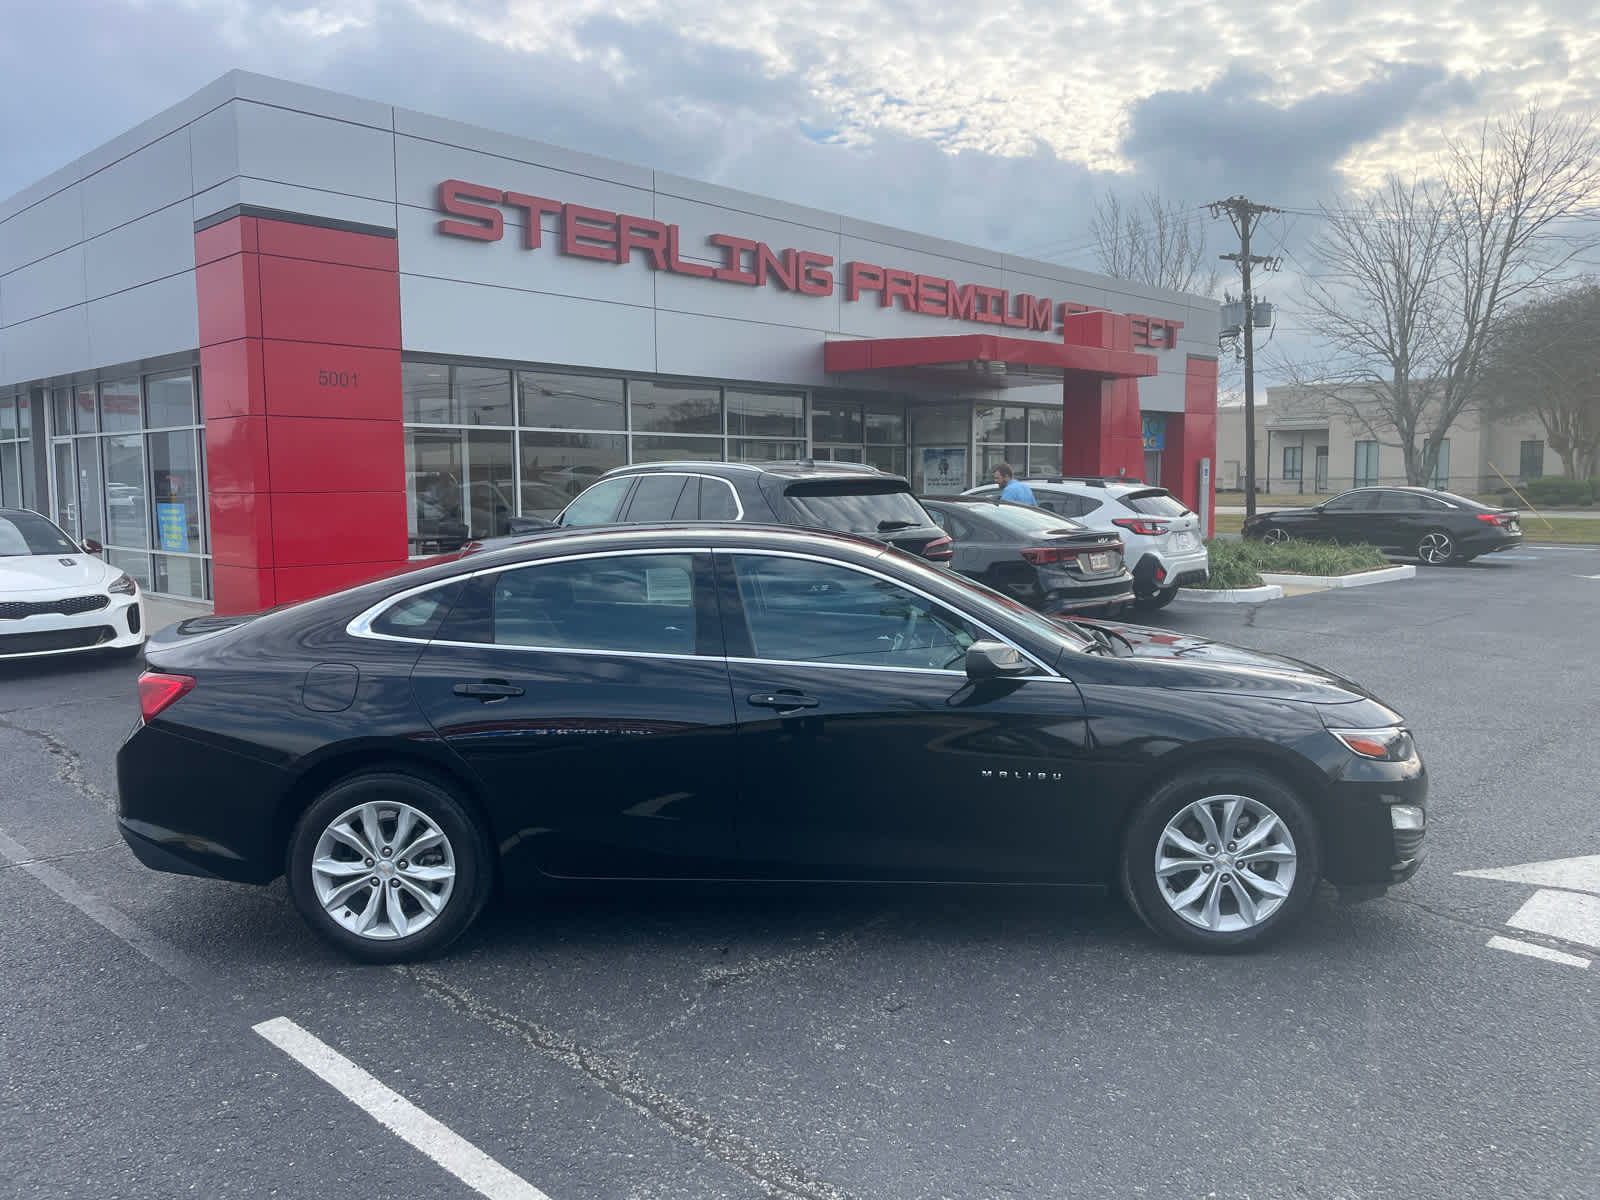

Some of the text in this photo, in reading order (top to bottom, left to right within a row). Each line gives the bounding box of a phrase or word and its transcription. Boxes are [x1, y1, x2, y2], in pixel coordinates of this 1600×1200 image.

[438, 179, 834, 297] STERLING
[846, 261, 1053, 332] PREMIUM
[318, 369, 358, 388] 5001
[982, 770, 1062, 780] MALIBU
